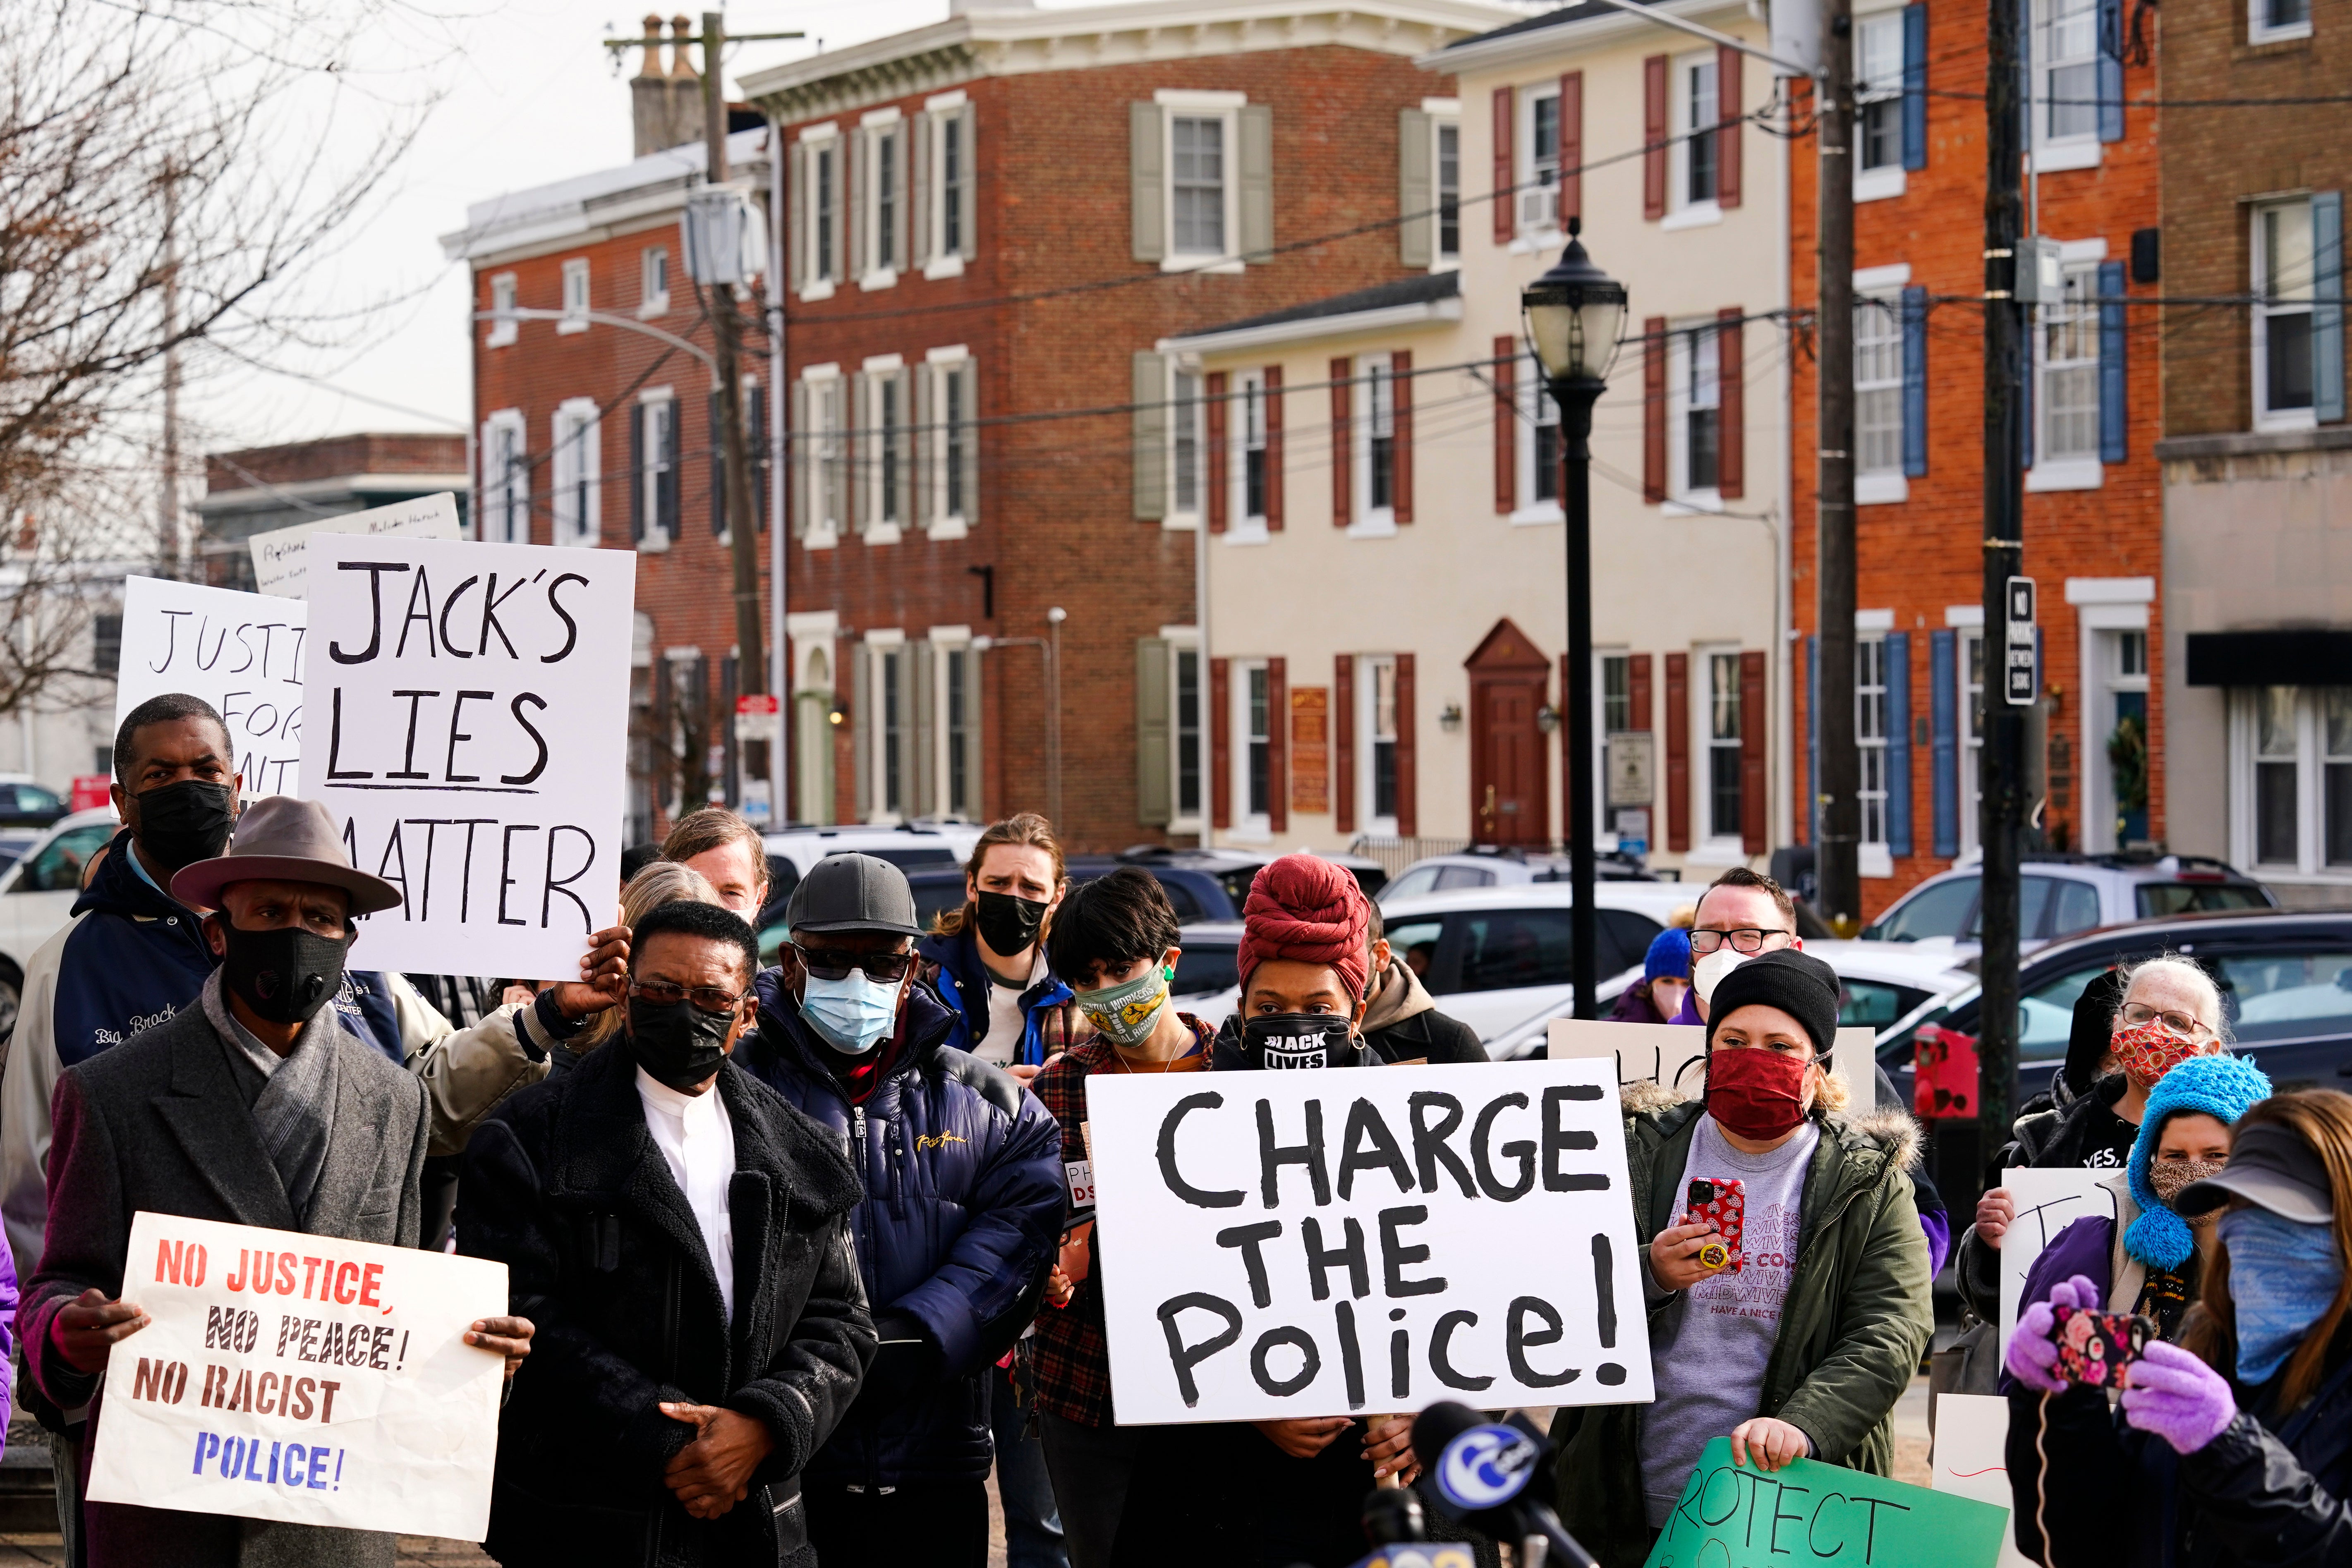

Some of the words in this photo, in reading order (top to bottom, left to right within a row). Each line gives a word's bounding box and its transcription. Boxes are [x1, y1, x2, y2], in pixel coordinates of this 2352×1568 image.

[329, 562, 590, 664] JACK'S
[149, 610, 307, 686] JUSTI
[223, 692, 302, 744] FOR
[327, 687, 548, 785] LIES
[95, 1028, 123, 1046] Big
[129, 1003, 176, 1037] Brock
[335, 1003, 363, 1016] CENTER
[1110, 985, 1154, 1011] WORKERS
[1264, 1032, 1327, 1051] BLACK
[1267, 1053, 1324, 1069] LIVES
[1155, 1084, 1611, 1209] CHARGE
[2082, 1147, 2120, 1168] YES,
[154, 1238, 208, 1288] NO
[227, 1248, 394, 1316] JUSTICE,
[1216, 1204, 1449, 1309] THE
[205, 1305, 259, 1353] NO
[277, 1314, 409, 1371] PEACE!
[1157, 1232, 1628, 1410] Police!
[1711, 1305, 1738, 1316] HAVE
[1739, 1308, 1748, 1317] A
[1749, 1308, 1776, 1319] NICE
[133, 1357, 188, 1405] NO
[201, 1364, 340, 1424] RACIST
[192, 1431, 345, 1491] POLICE!
